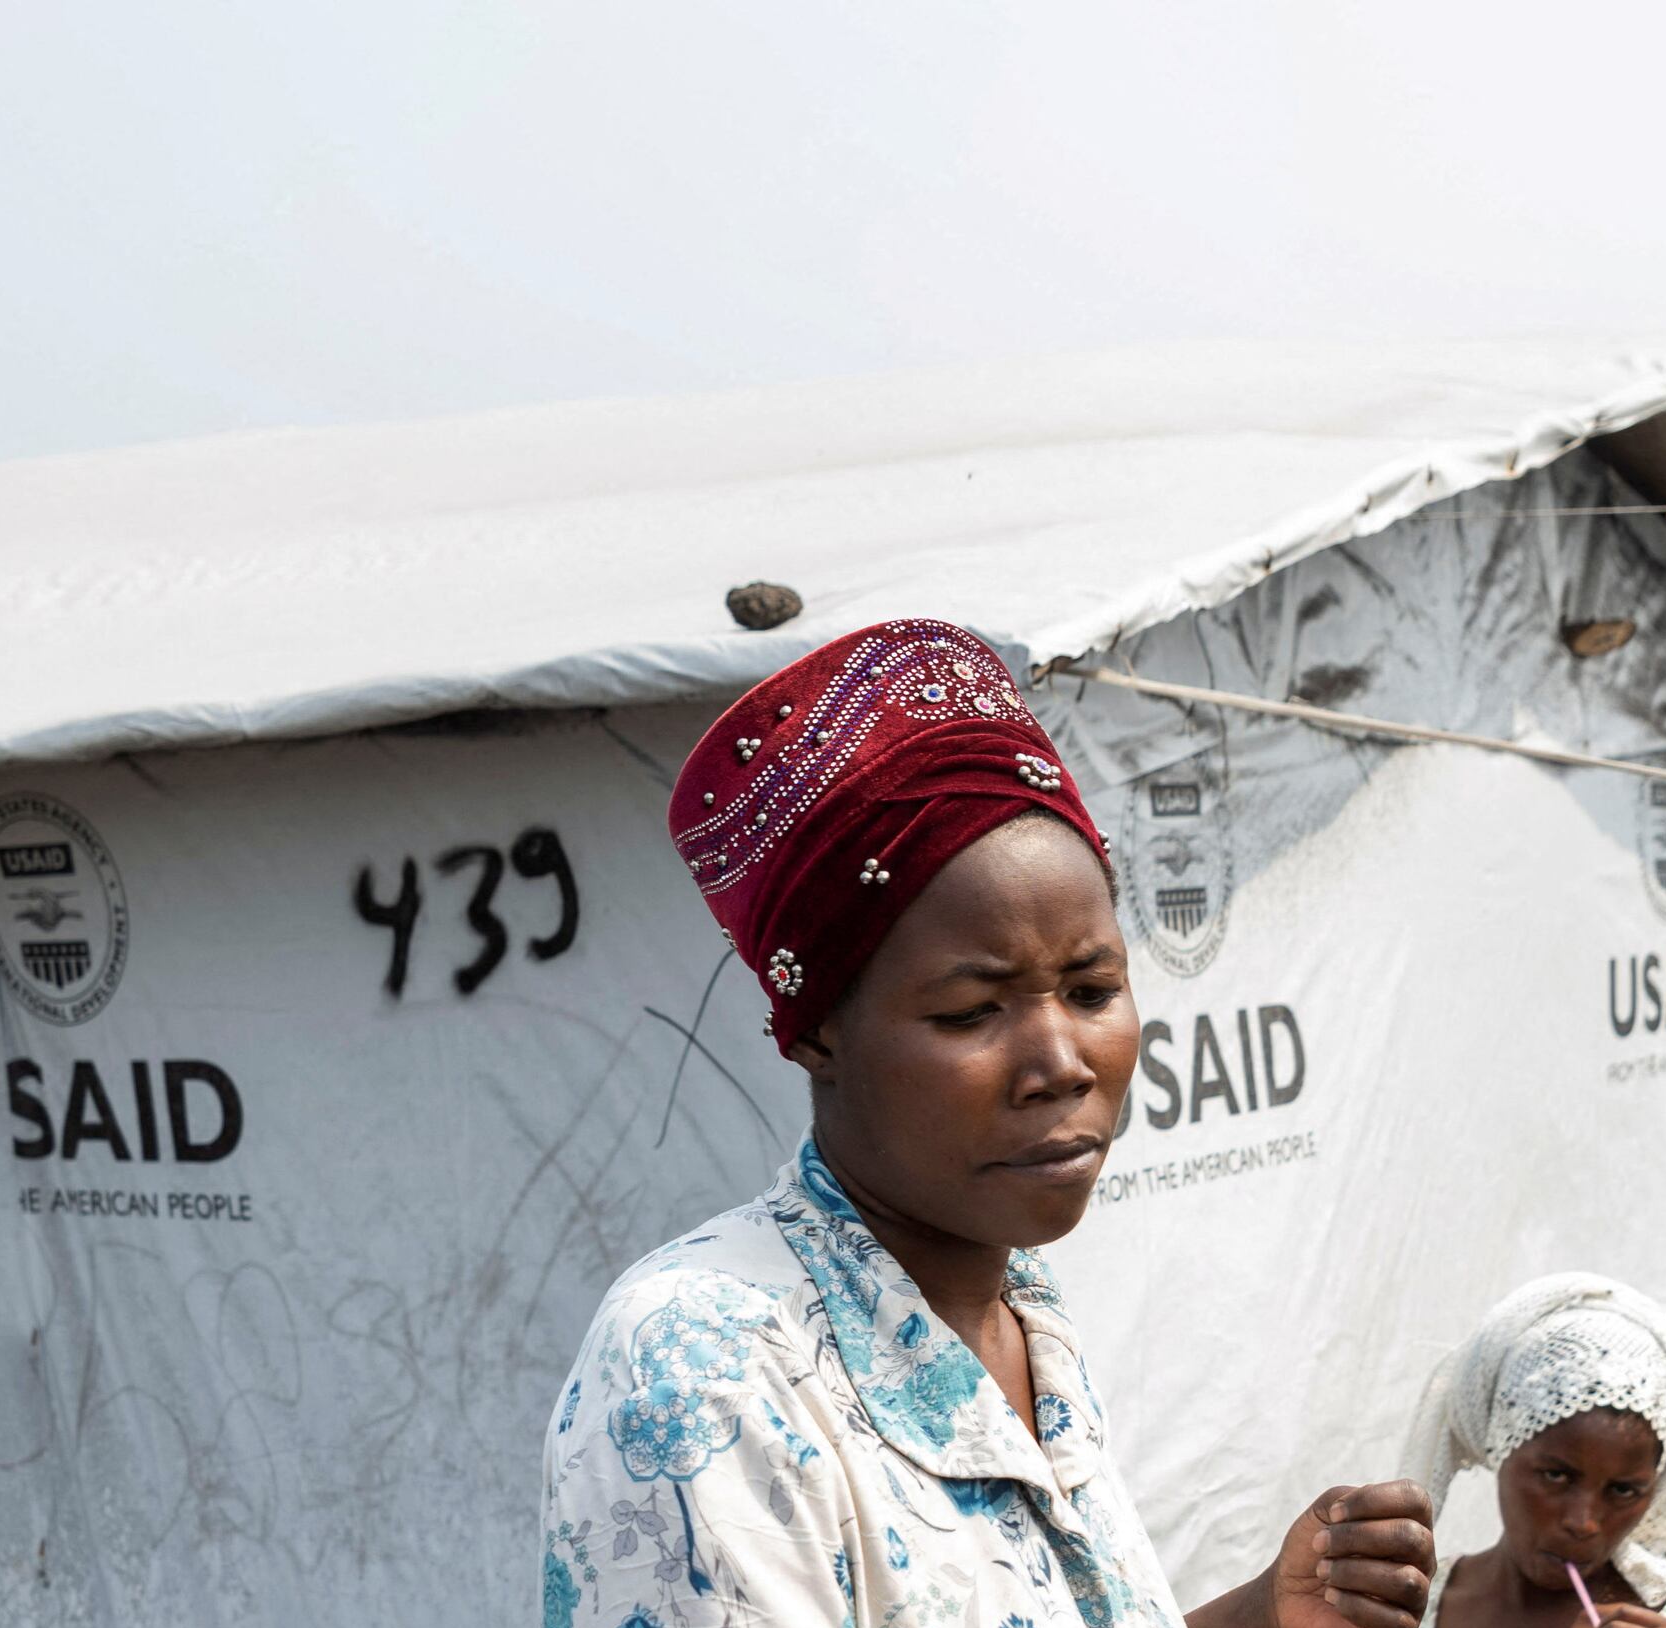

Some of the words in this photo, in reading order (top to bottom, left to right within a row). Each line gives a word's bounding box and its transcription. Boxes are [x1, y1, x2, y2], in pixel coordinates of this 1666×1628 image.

[4, 847, 66, 873] USAID
[353, 826, 580, 1000] 439
[5, 1056, 244, 1164] SAID
[1143, 1162, 1178, 1195] THE
[1182, 1145, 1263, 1186] AMERICAN
[1267, 1131, 1316, 1166] PEOPLE
[168, 1193, 252, 1222] PEOPLE
